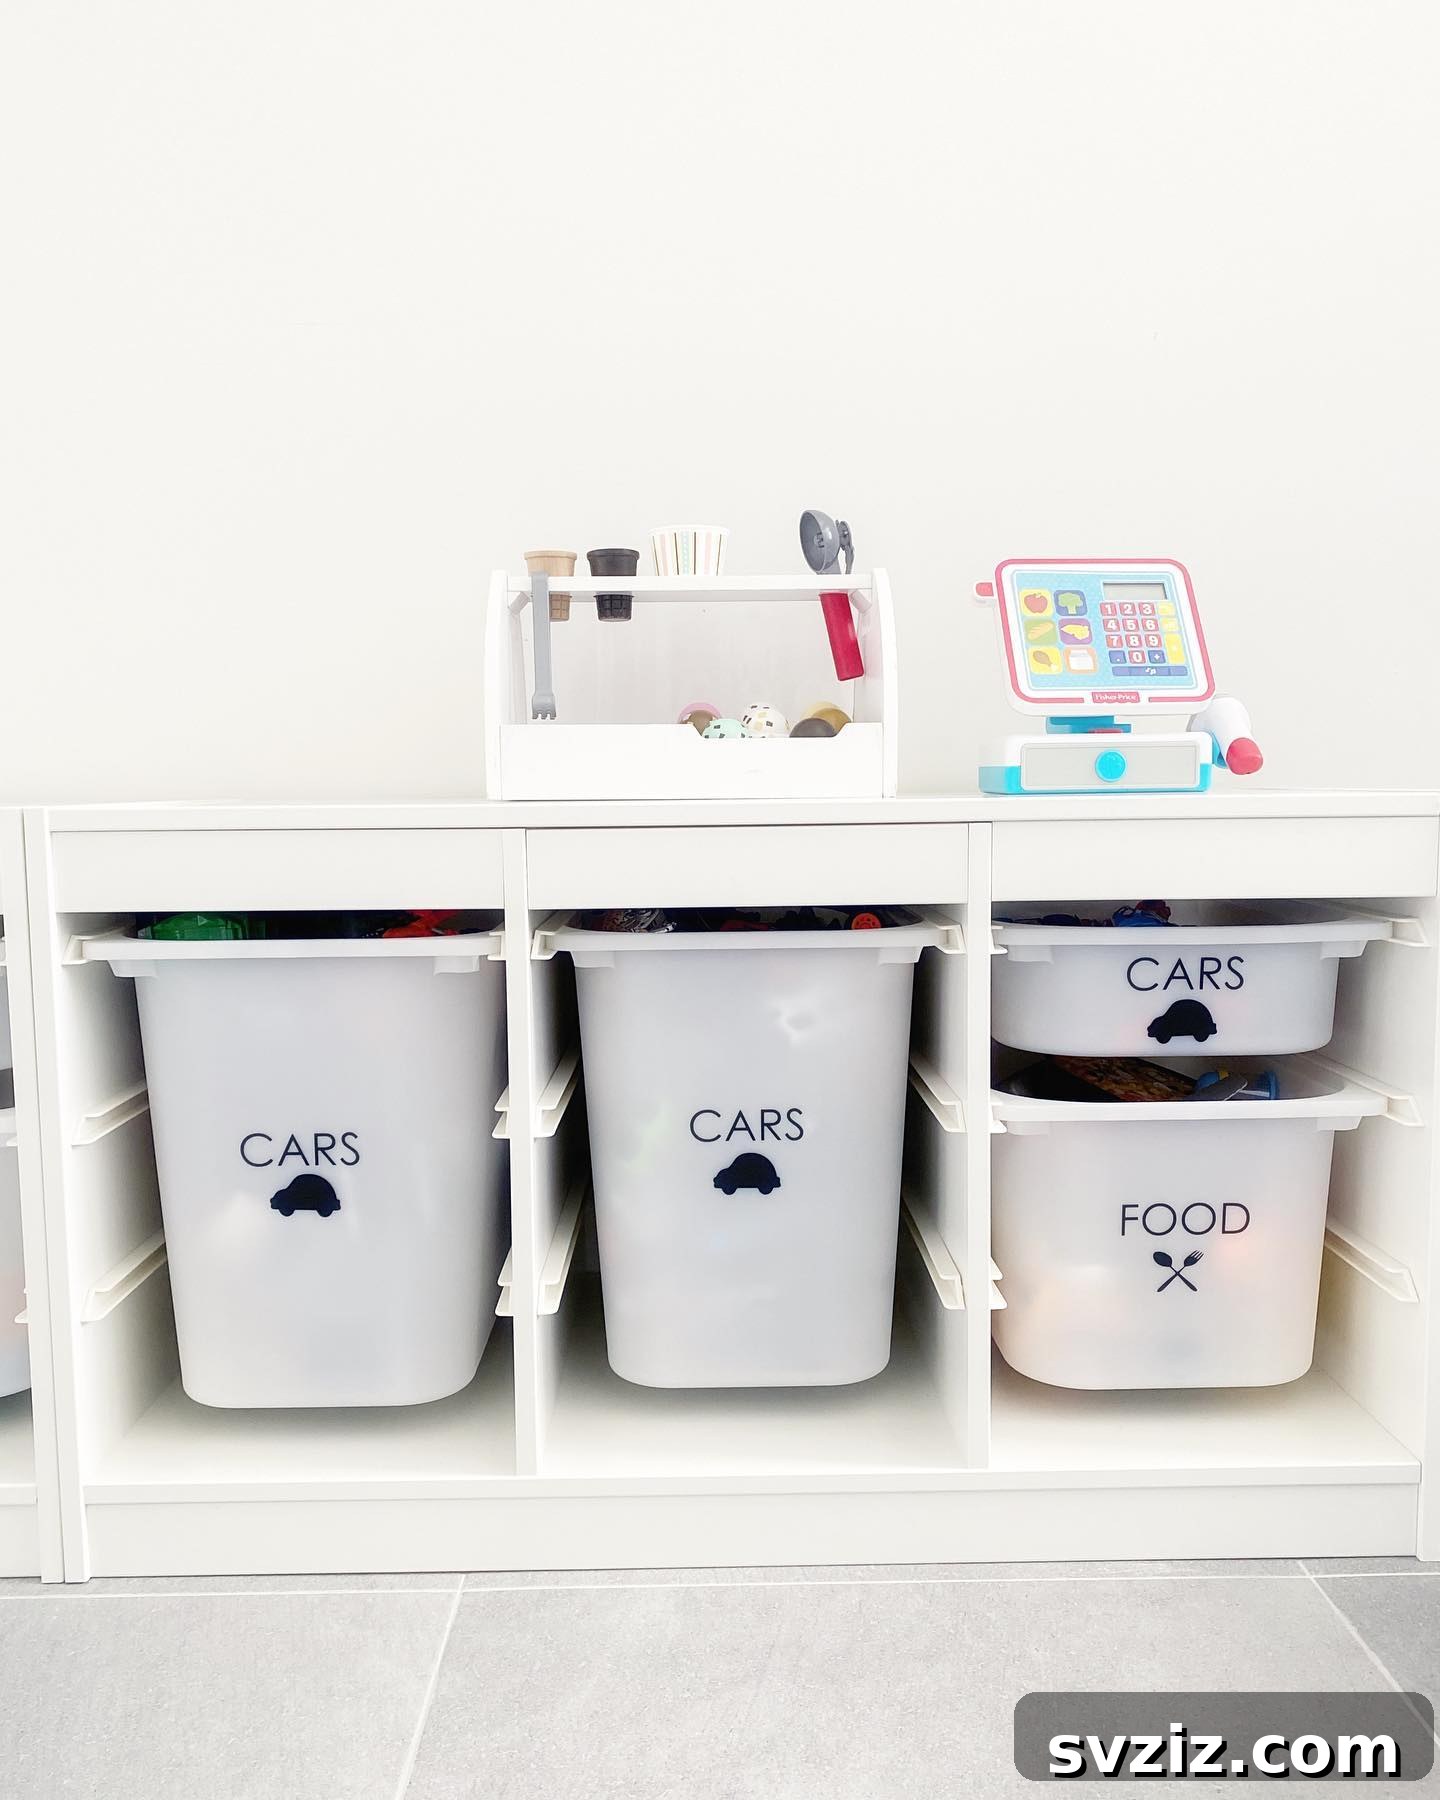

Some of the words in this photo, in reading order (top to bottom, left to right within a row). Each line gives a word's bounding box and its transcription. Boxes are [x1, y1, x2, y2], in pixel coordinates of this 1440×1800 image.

[1105, 604, 1112, 614] 1
[1124, 604, 1133, 614] 2
[1142, 604, 1152, 614] 3
[1107, 620, 1117, 630] 4
[1127, 620, 1136, 630] 5
[1145, 620, 1155, 630] 6
[1110, 636, 1119, 647] 7
[1129, 636, 1139, 646] 8
[1148, 636, 1159, 646] 9
[1132, 652, 1142, 662] 0
[1126, 955, 1245, 992] CARS
[689, 1107, 805, 1143] CARS
[240, 1131, 360, 1168] CARS
[1121, 1202, 1251, 1238] FOOD
